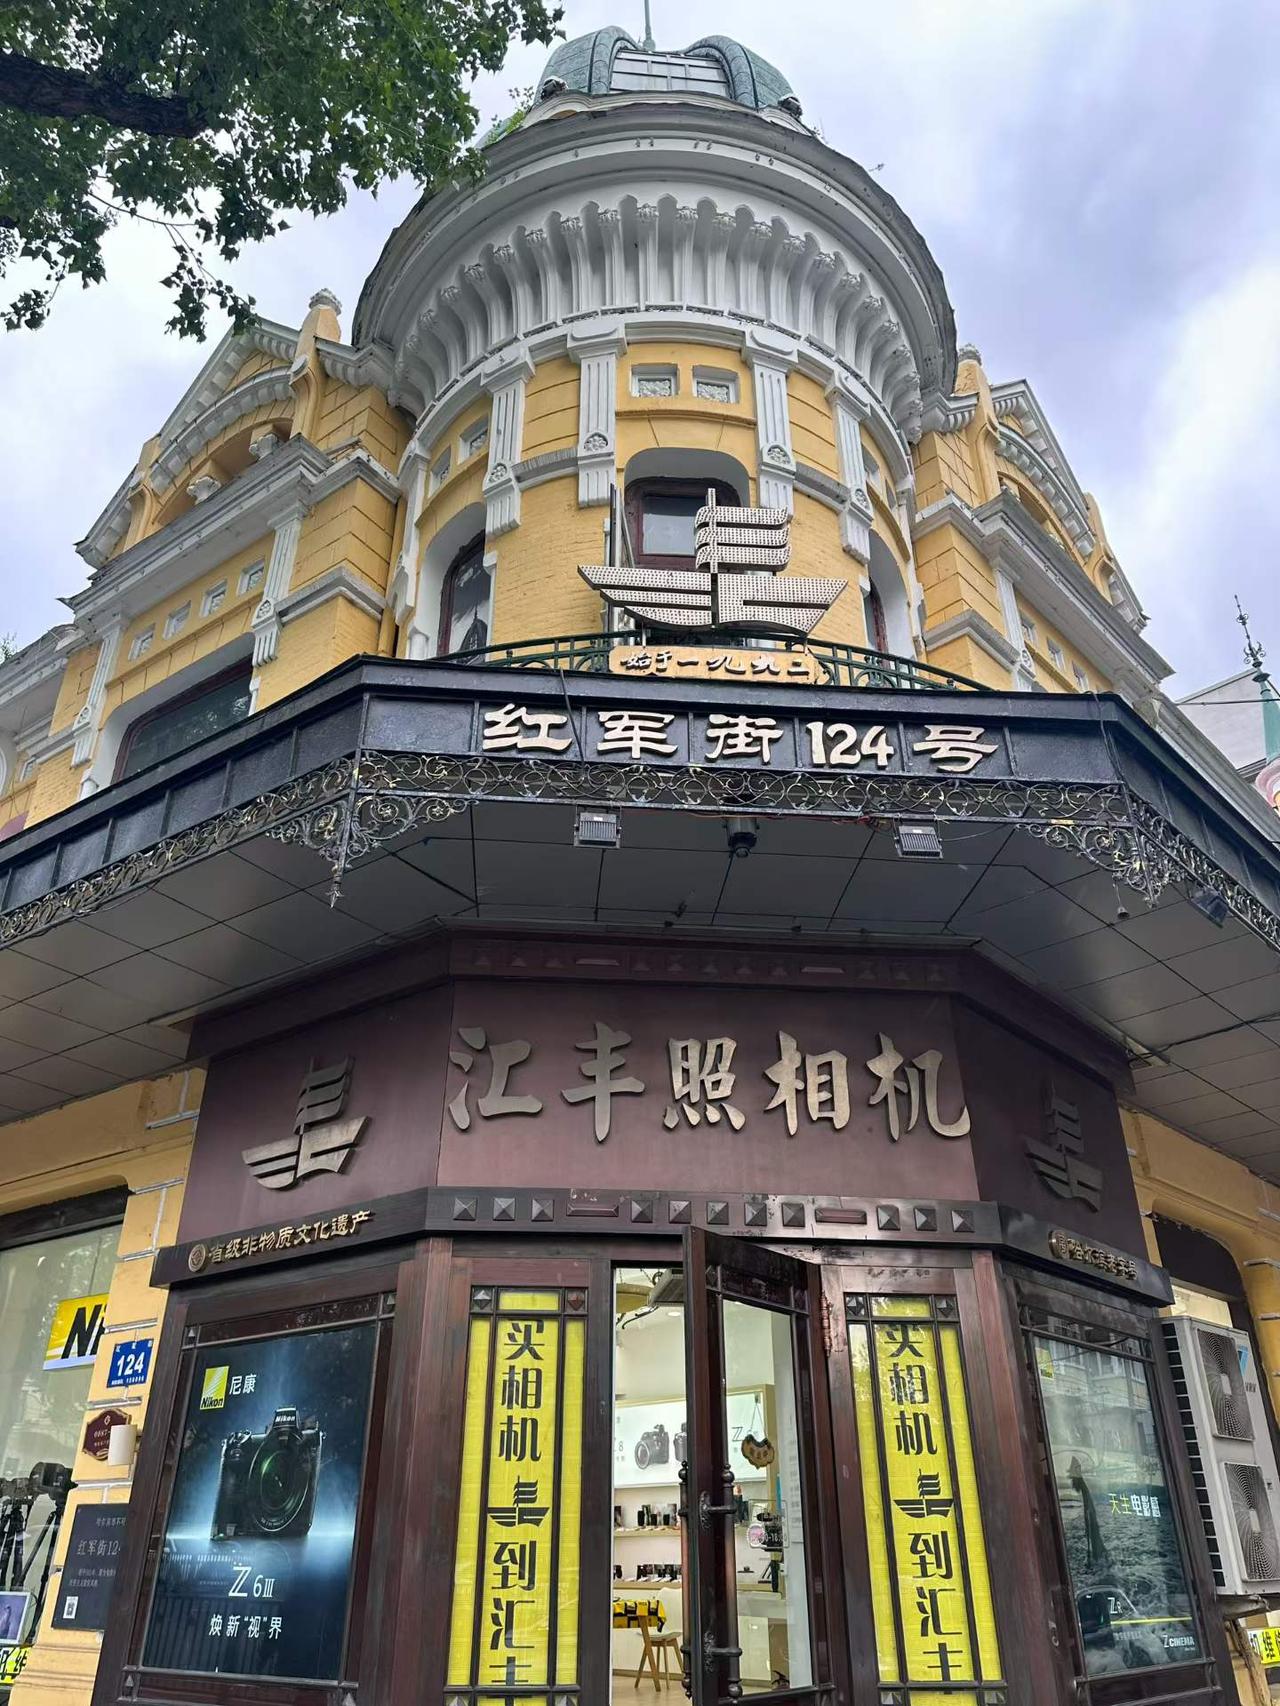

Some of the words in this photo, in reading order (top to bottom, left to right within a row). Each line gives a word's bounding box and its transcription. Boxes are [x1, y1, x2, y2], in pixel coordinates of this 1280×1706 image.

[620, 651, 810, 676] 始于一九九二
[483, 703, 998, 773] 红军街124号
[448, 1021, 972, 1142] 汇丰照相机
[209, 1210, 371, 1263] 省级非物质文化遗产
[117, 1352, 145, 1376] 124
[229, 1374, 256, 1395] 尼康
[498, 1319, 545, 1462] 买相机
[884, 1323, 938, 1456] 买相机
[201, 1397, 224, 1408] Nikon
[1108, 1493, 1161, 1518] 天生电影感
[77, 1540, 121, 1556] 红军街12
